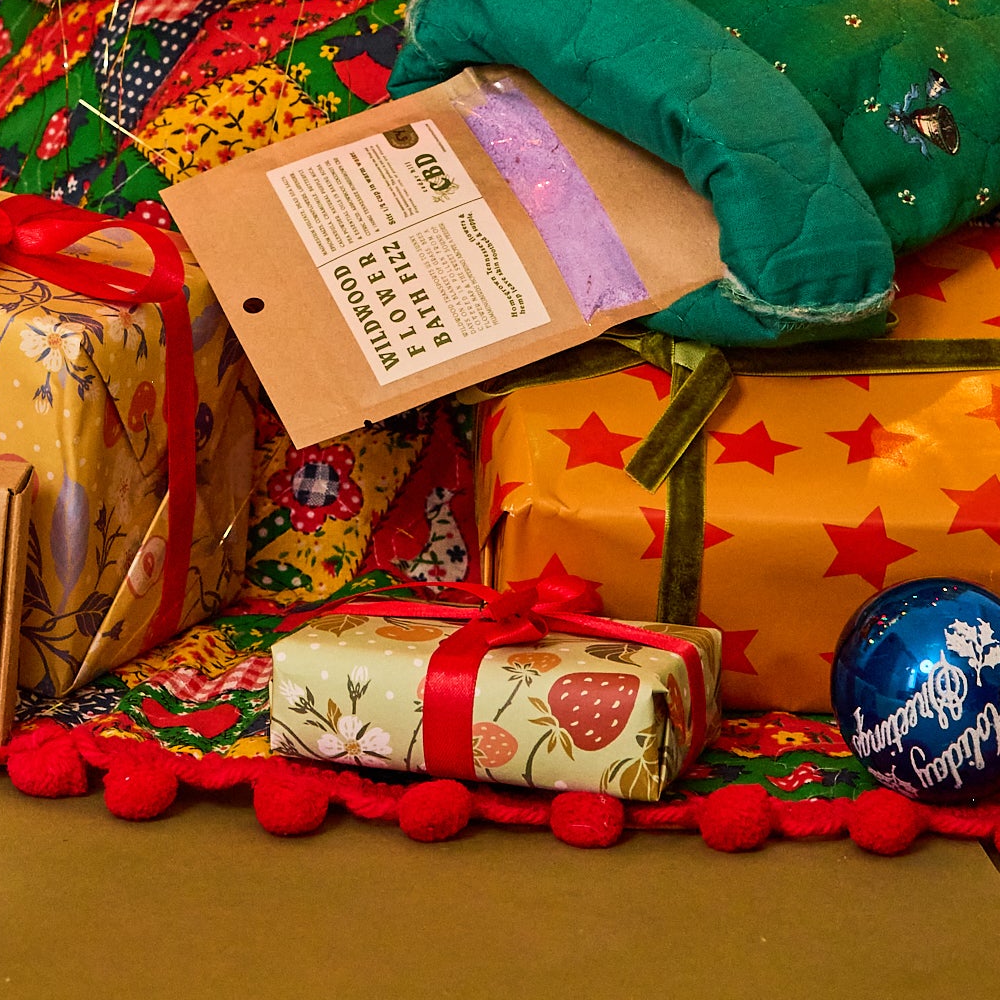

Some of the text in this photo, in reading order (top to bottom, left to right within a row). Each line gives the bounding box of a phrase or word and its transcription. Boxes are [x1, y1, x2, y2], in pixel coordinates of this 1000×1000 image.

[358, 167, 371, 183] warm
[404, 160, 428, 192] cedar hill
[412, 150, 452, 193] CBD
[367, 183, 376, 191] in
[372, 190, 384, 202] cup
[384, 212, 396, 225] Stir
[461, 220, 476, 242] flowers
[426, 235, 441, 253] FROM
[481, 236, 498, 260] soothed
[383, 240, 417, 288] FIZZ
[438, 256, 457, 282] POLLEN
[476, 242, 492, 275] Tennessee
[494, 261, 504, 276] skin
[427, 269, 450, 303] TRANSPORTS
[440, 275, 458, 300] BLANKET
[456, 272, 466, 282] THE
[502, 277, 518, 293] leave
[359, 252, 426, 358] FLOWER
[491, 276, 518, 317] Homegrown
[516, 293, 526, 314] hemp
[334, 265, 399, 371] WILDWOOD
[410, 289, 453, 347] BATH
[446, 304, 470, 337] WILDWOOD
[460, 295, 485, 331] COVERED
[463, 317, 477, 334] DAYS
[473, 302, 492, 328] FLOWER
[852, 649, 968, 758] Greetings
